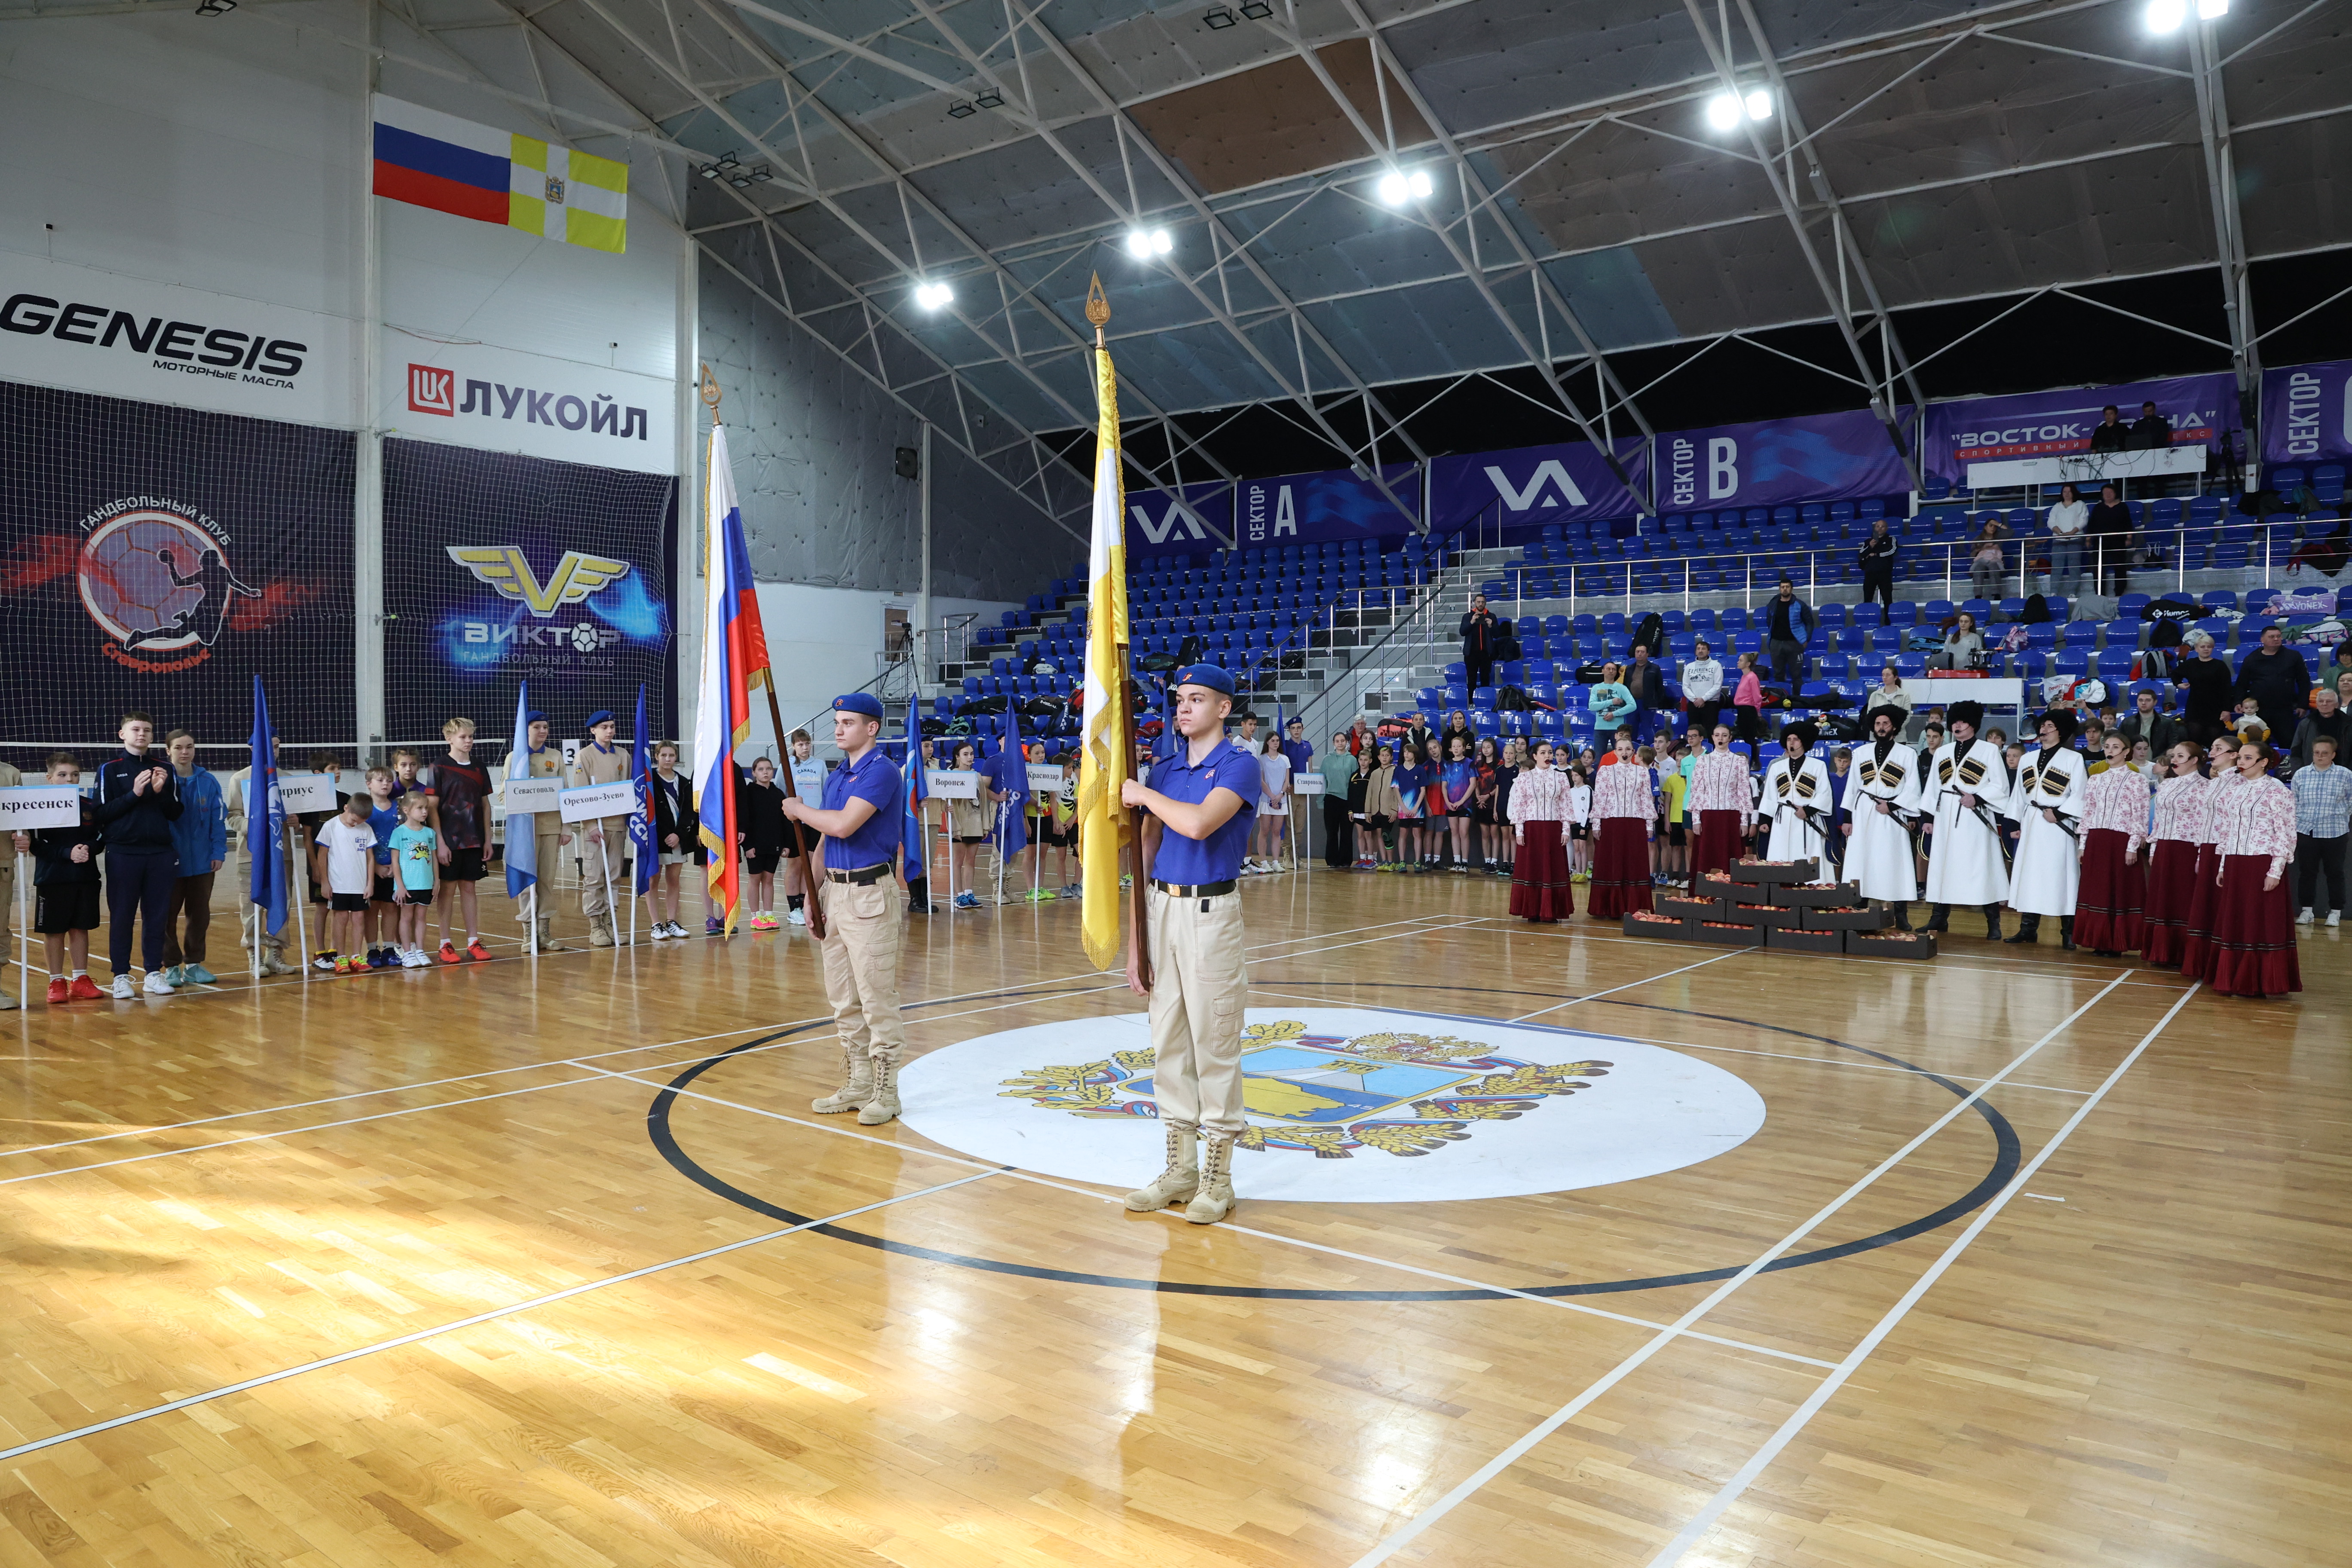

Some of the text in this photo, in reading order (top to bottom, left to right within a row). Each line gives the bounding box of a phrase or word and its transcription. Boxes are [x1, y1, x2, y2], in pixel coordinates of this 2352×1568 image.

[0, 294, 308, 376] GENESIS
[153, 360, 294, 389] МОТОРНЫЕ МАСЛА
[460, 379, 647, 440] ЛУКОЙЛ
[2288, 373, 2321, 454] СЕКТОР
[1960, 441, 2079, 457] СПОРТИВНЫЙ
[1674, 438, 1694, 505] СЕКТОР
[80, 496, 231, 546] ГАНДБОЛЬНЫЙ КЛУБ
[1250, 485, 1265, 541] СЕКТОР
[2295, 601, 2324, 610] YONEX
[464, 622, 620, 652] ВИКТОР
[102, 642, 211, 674] Ставрополье
[463, 650, 614, 667] ГАНДБОЛЬНЫЙ КЛУБ
[529, 668, 554, 677] 1992
[567, 747, 575, 764] 3
[935, 778, 965, 787] Воронеж
[1027, 771, 1059, 781] Краснодар
[1297, 778, 1323, 787] Ставрополь
[279, 787, 313, 798] ириус
[513, 785, 555, 795] Севастополь
[564, 790, 624, 806] Орехово-Зуево
[0, 800, 73, 813] кресенск
